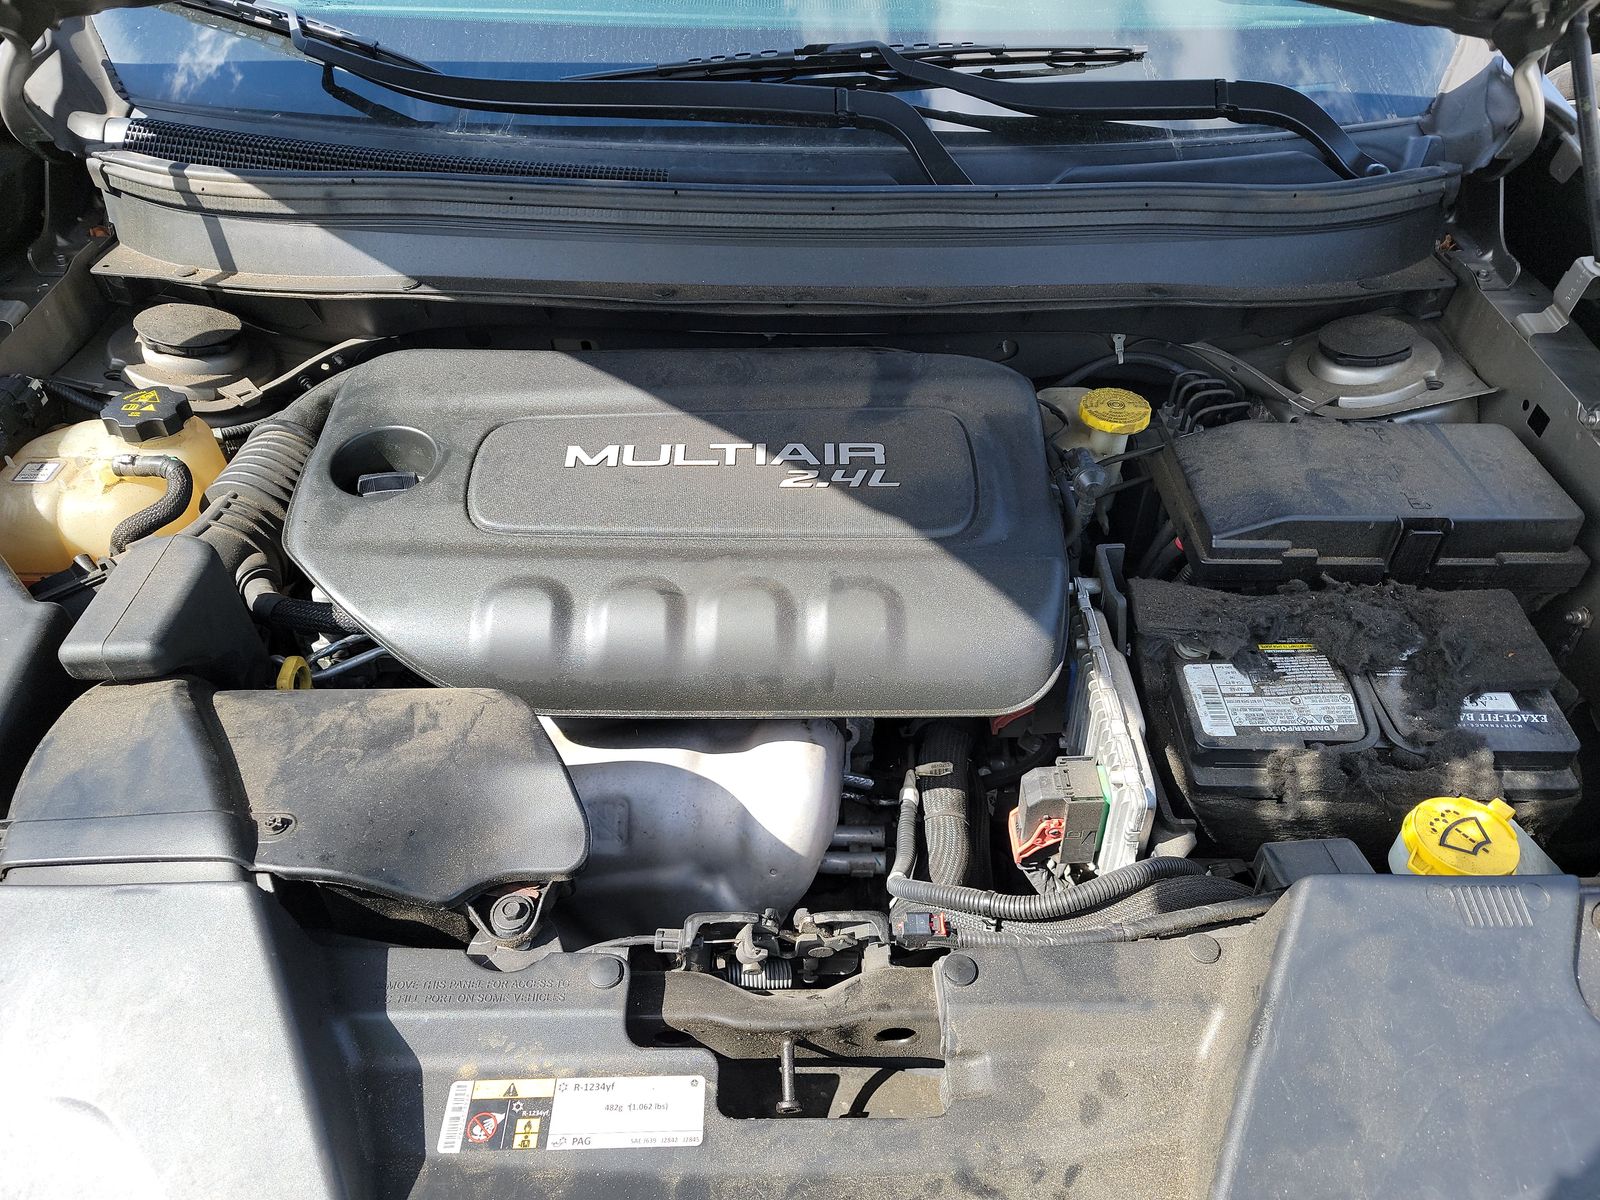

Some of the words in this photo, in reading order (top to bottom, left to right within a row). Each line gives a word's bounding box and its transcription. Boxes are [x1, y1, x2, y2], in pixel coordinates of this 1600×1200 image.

[564, 442, 887, 468] MULTIAIR
[778, 468, 901, 489] 2.4L
[1460, 713, 1475, 722] BA
[1479, 713, 1548, 723] EXACT-FIT
[449, 980, 483, 989] PANEL
[486, 979, 509, 989] FOR
[510, 979, 553, 988] ACCESS
[556, 979, 570, 988] TO
[424, 994, 453, 1003] PORT
[457, 993, 475, 1003] ON
[477, 993, 511, 1003] SOME
[514, 992, 566, 1002] VEHICLES
[573, 1082, 615, 1093] R-1234yf
[604, 1103, 623, 1113] 482g
[571, 1137, 591, 1146] PAG
